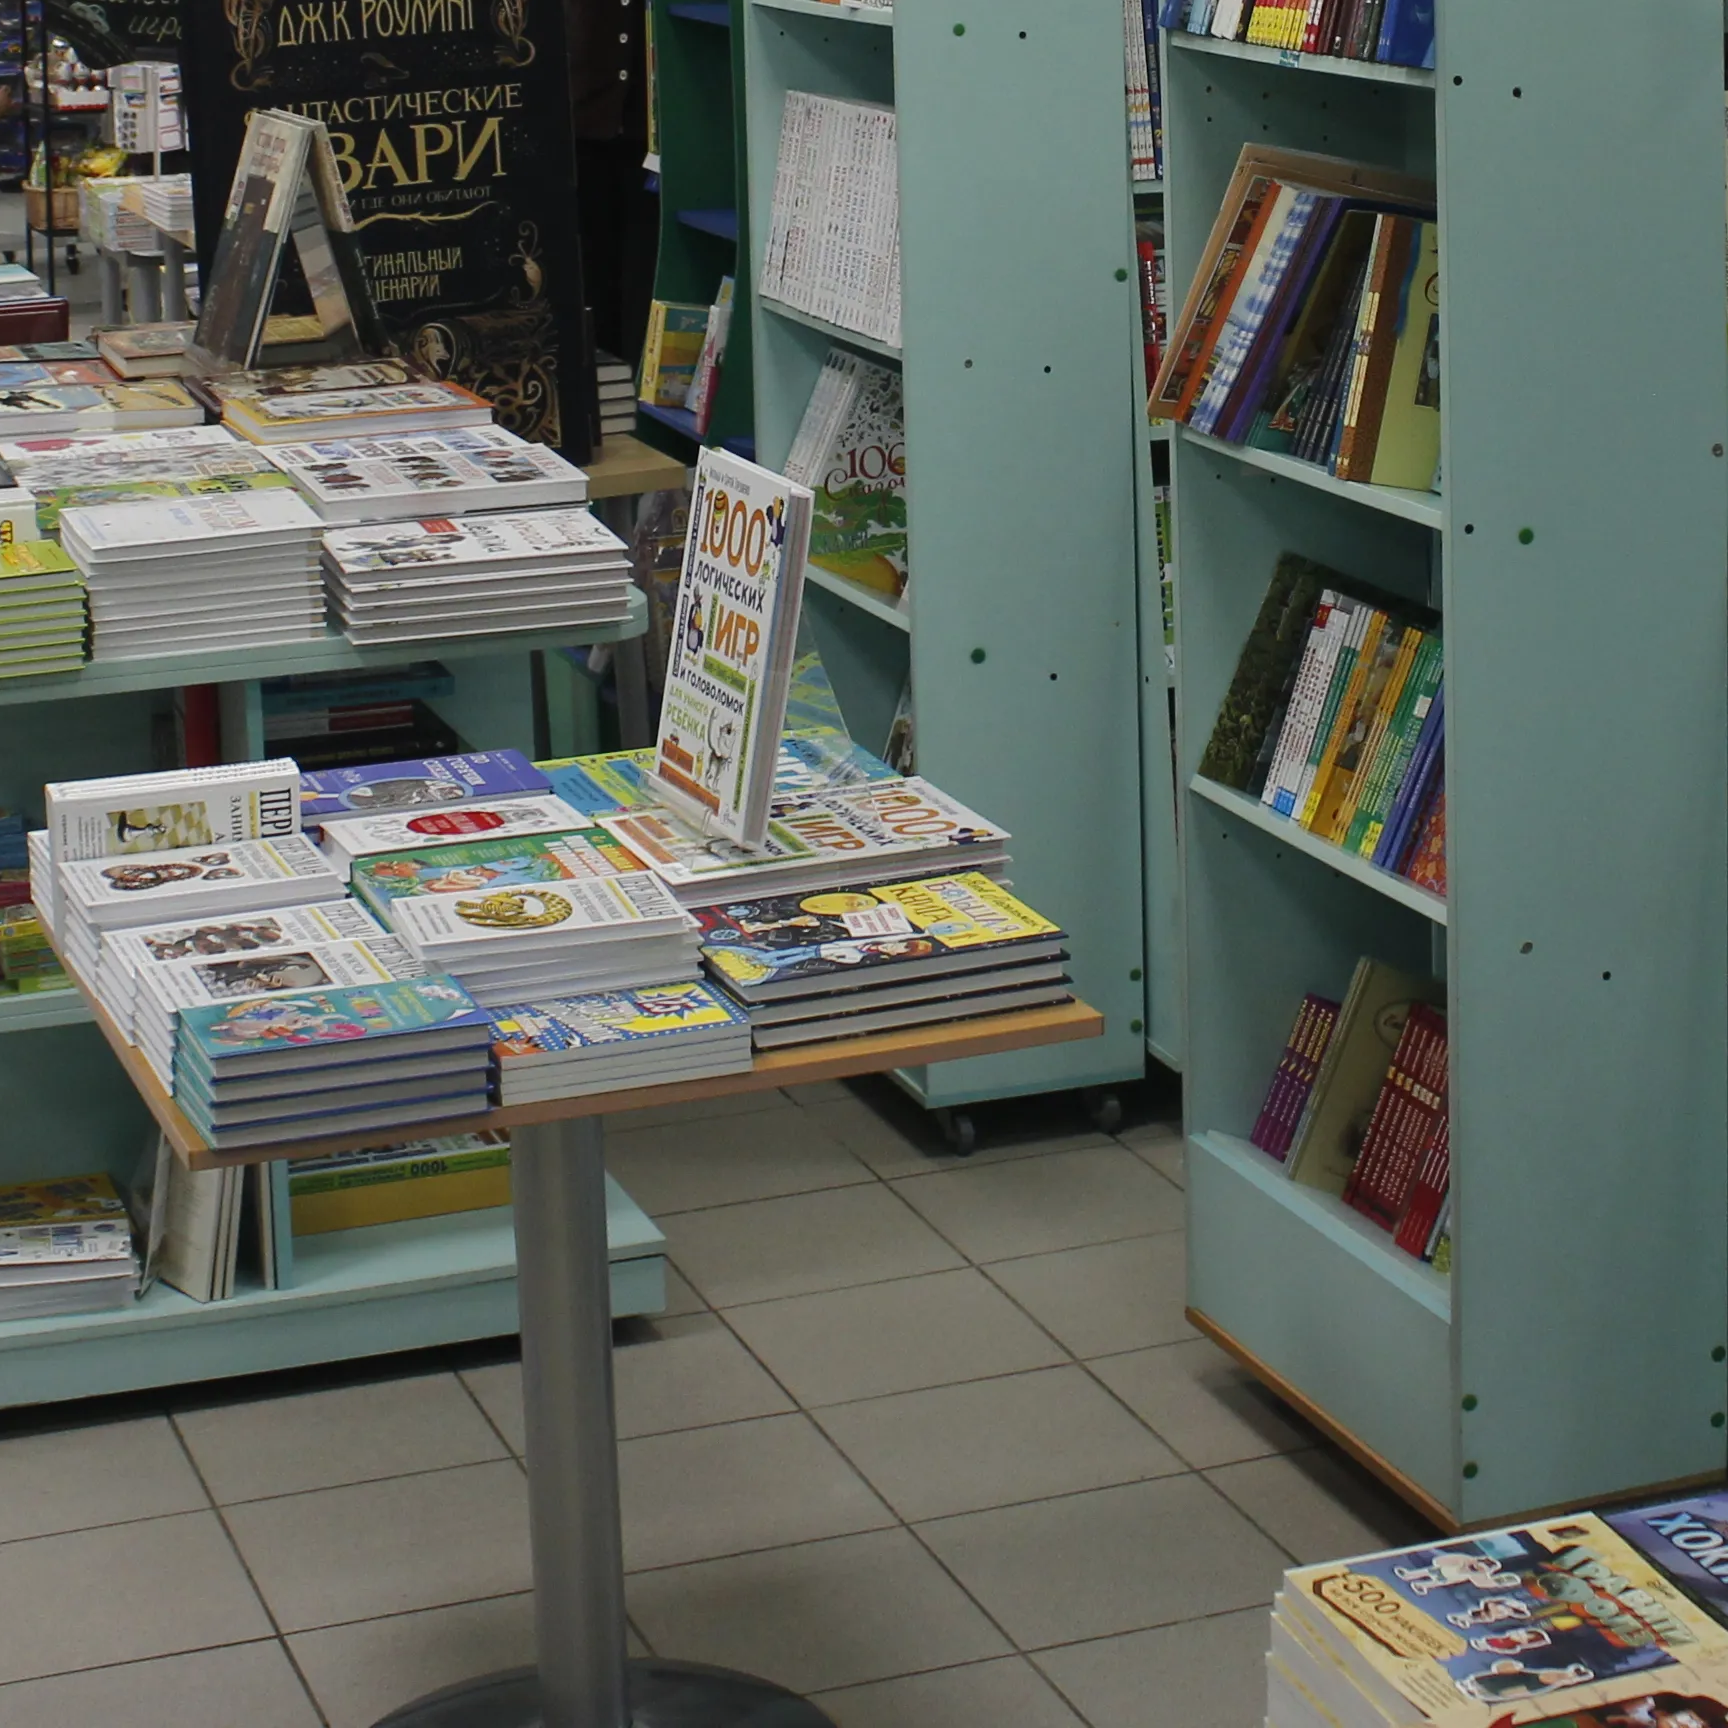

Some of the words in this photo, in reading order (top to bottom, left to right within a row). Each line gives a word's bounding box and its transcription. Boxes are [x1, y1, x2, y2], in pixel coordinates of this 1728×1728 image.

[326, 115, 509, 194] ВАРИ
[391, 191, 422, 208] ОНИ
[699, 489, 768, 578] 1000
[693, 558, 767, 615] ЛОГИЧЕСКИХ
[713, 603, 761, 668] ИГР
[686, 669, 745, 718] ГОЛОВОЛОМОК
[663, 702, 708, 742] РЕБЁНКА
[887, 884, 952, 924] КНИГА
[923, 879, 1022, 935] БОЛЬШАЯ
